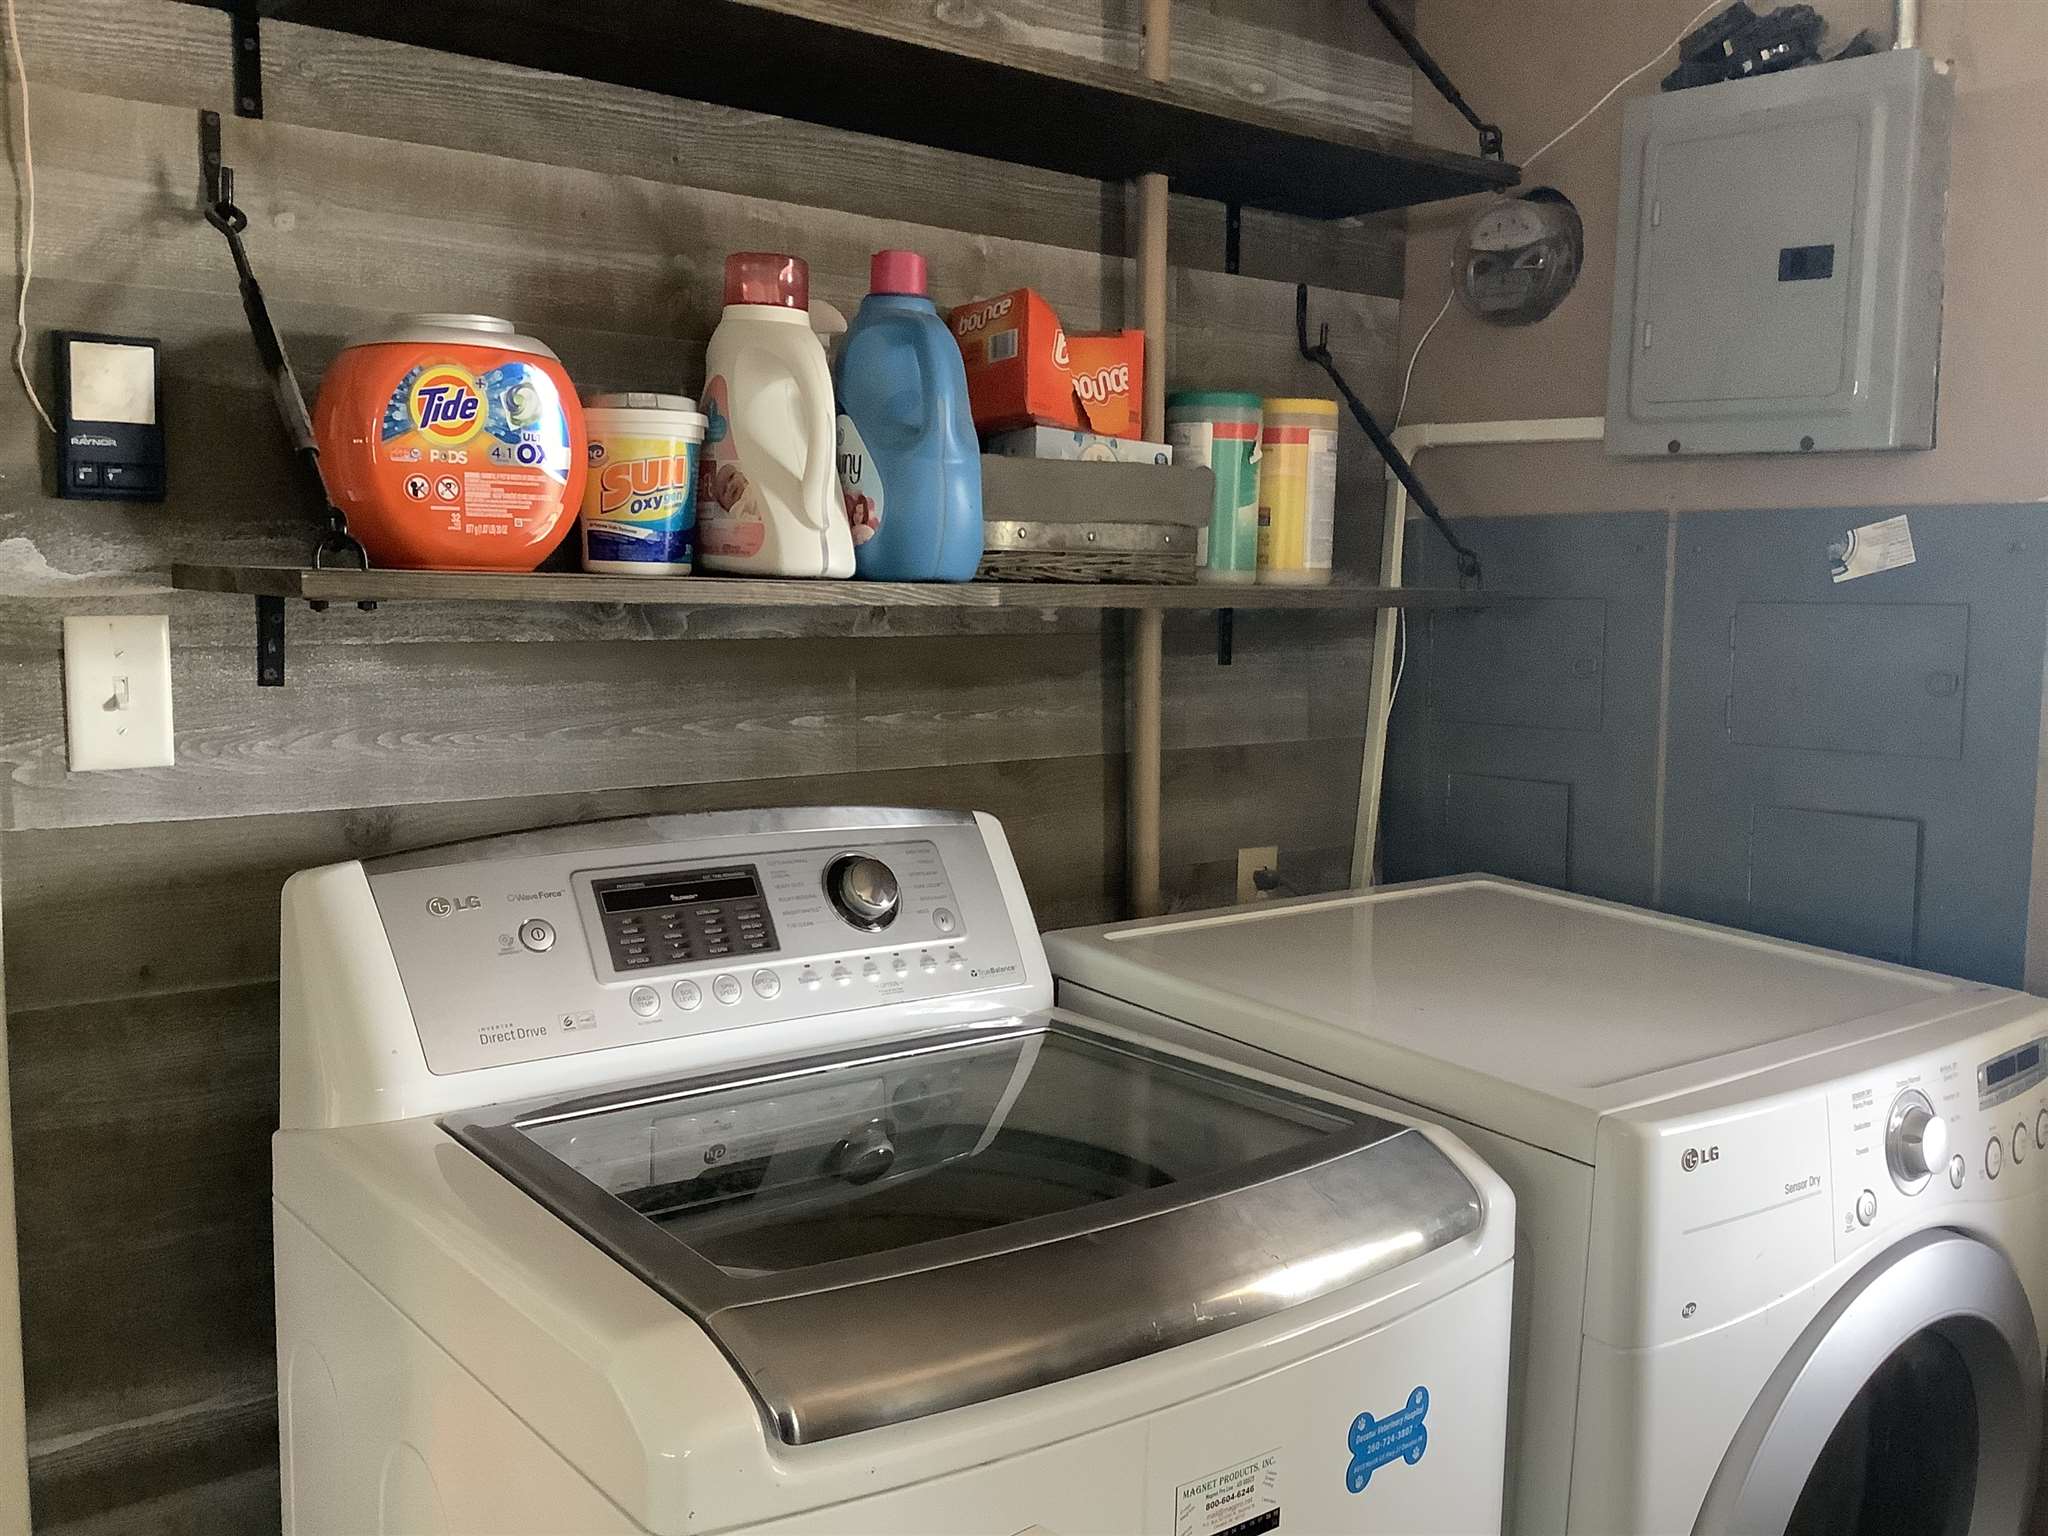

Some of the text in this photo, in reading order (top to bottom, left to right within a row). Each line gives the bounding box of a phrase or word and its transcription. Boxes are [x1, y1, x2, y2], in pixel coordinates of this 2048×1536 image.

[418, 386, 479, 430] Tide
[70, 436, 118, 447] RAYNOR
[453, 896, 482, 912] LG
[1700, 1146, 1720, 1164] LG
[1784, 1175, 1821, 1195] Sensor Dry
[1182, 1478, 1219, 1499] MAGNET
[1204, 1485, 1255, 1512] 800-604-6246
